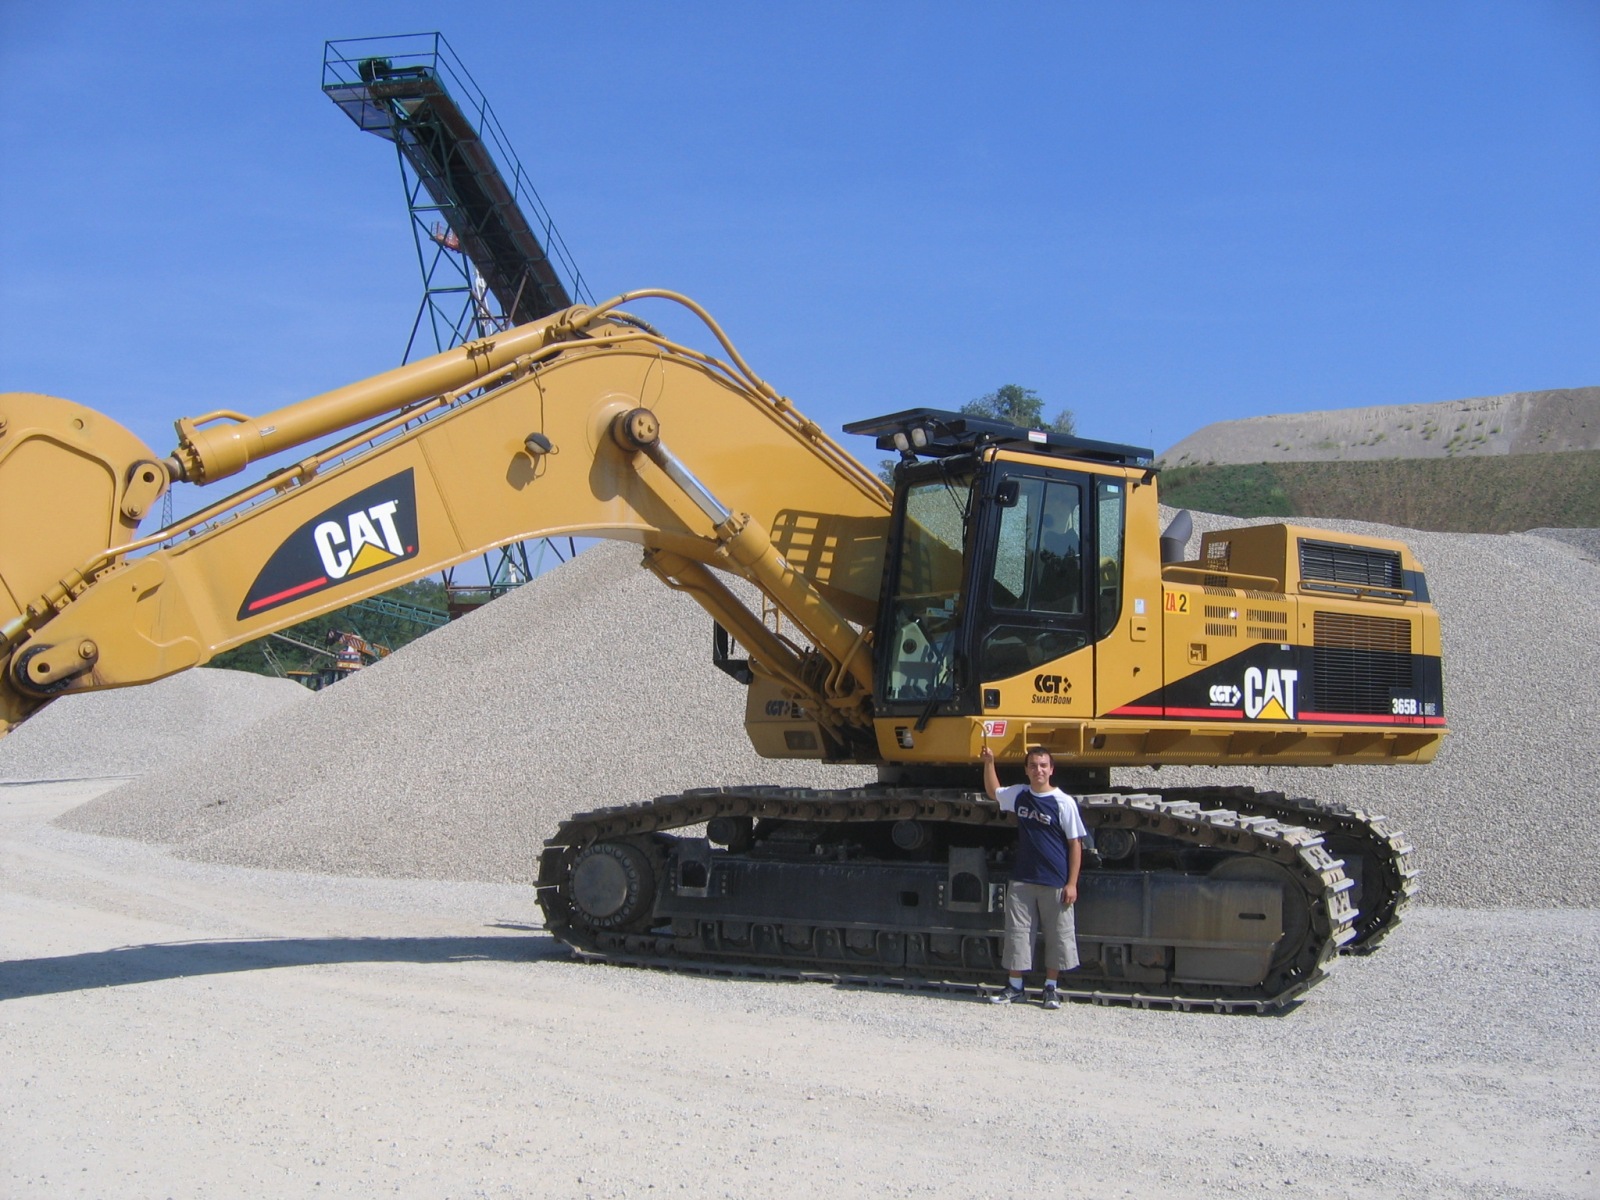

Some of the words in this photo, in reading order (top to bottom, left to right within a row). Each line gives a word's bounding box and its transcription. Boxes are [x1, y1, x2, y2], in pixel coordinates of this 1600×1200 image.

[314, 500, 405, 579] CAT
[1165, 592, 1176, 612] ZA
[1179, 593, 1187, 612] 2
[1034, 674, 1062, 694] CGT
[1244, 666, 1298, 720] CAT
[1392, 697, 1417, 715] 365B
